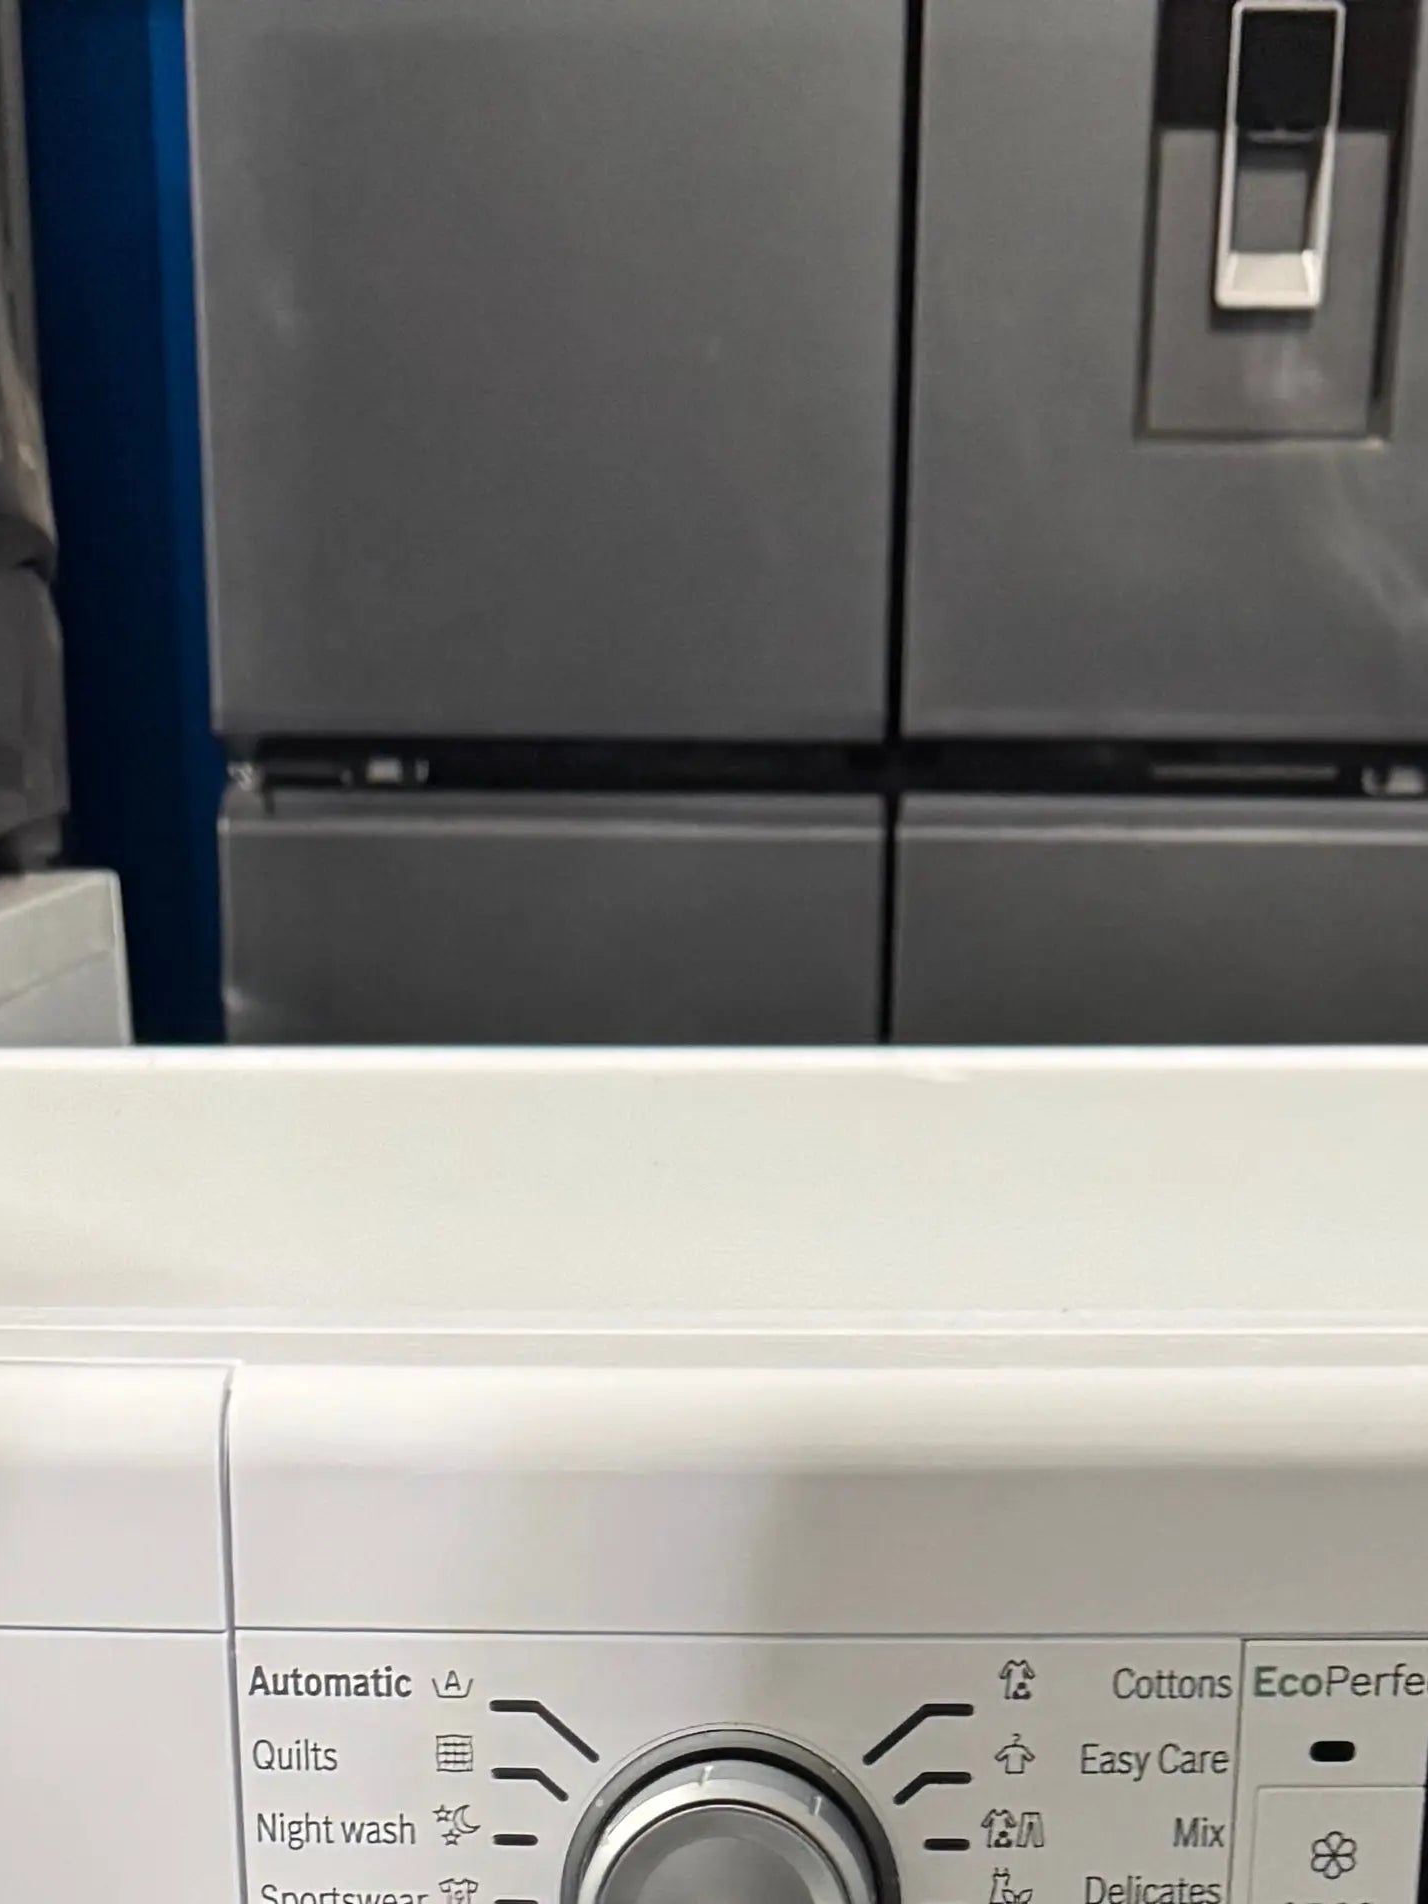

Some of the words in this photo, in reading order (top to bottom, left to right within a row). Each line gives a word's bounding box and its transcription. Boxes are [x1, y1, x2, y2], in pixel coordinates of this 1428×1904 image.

[249, 1666, 412, 1698] Automatic
[1112, 1667, 1233, 1700] Cottons
[252, 1739, 339, 1773] Quilts
[1080, 1744, 1150, 1781] Easy
[1158, 1744, 1230, 1774] Care
[257, 1812, 334, 1850] Night
[342, 1814, 417, 1846] wash
[1172, 1818, 1225, 1849] Mix
